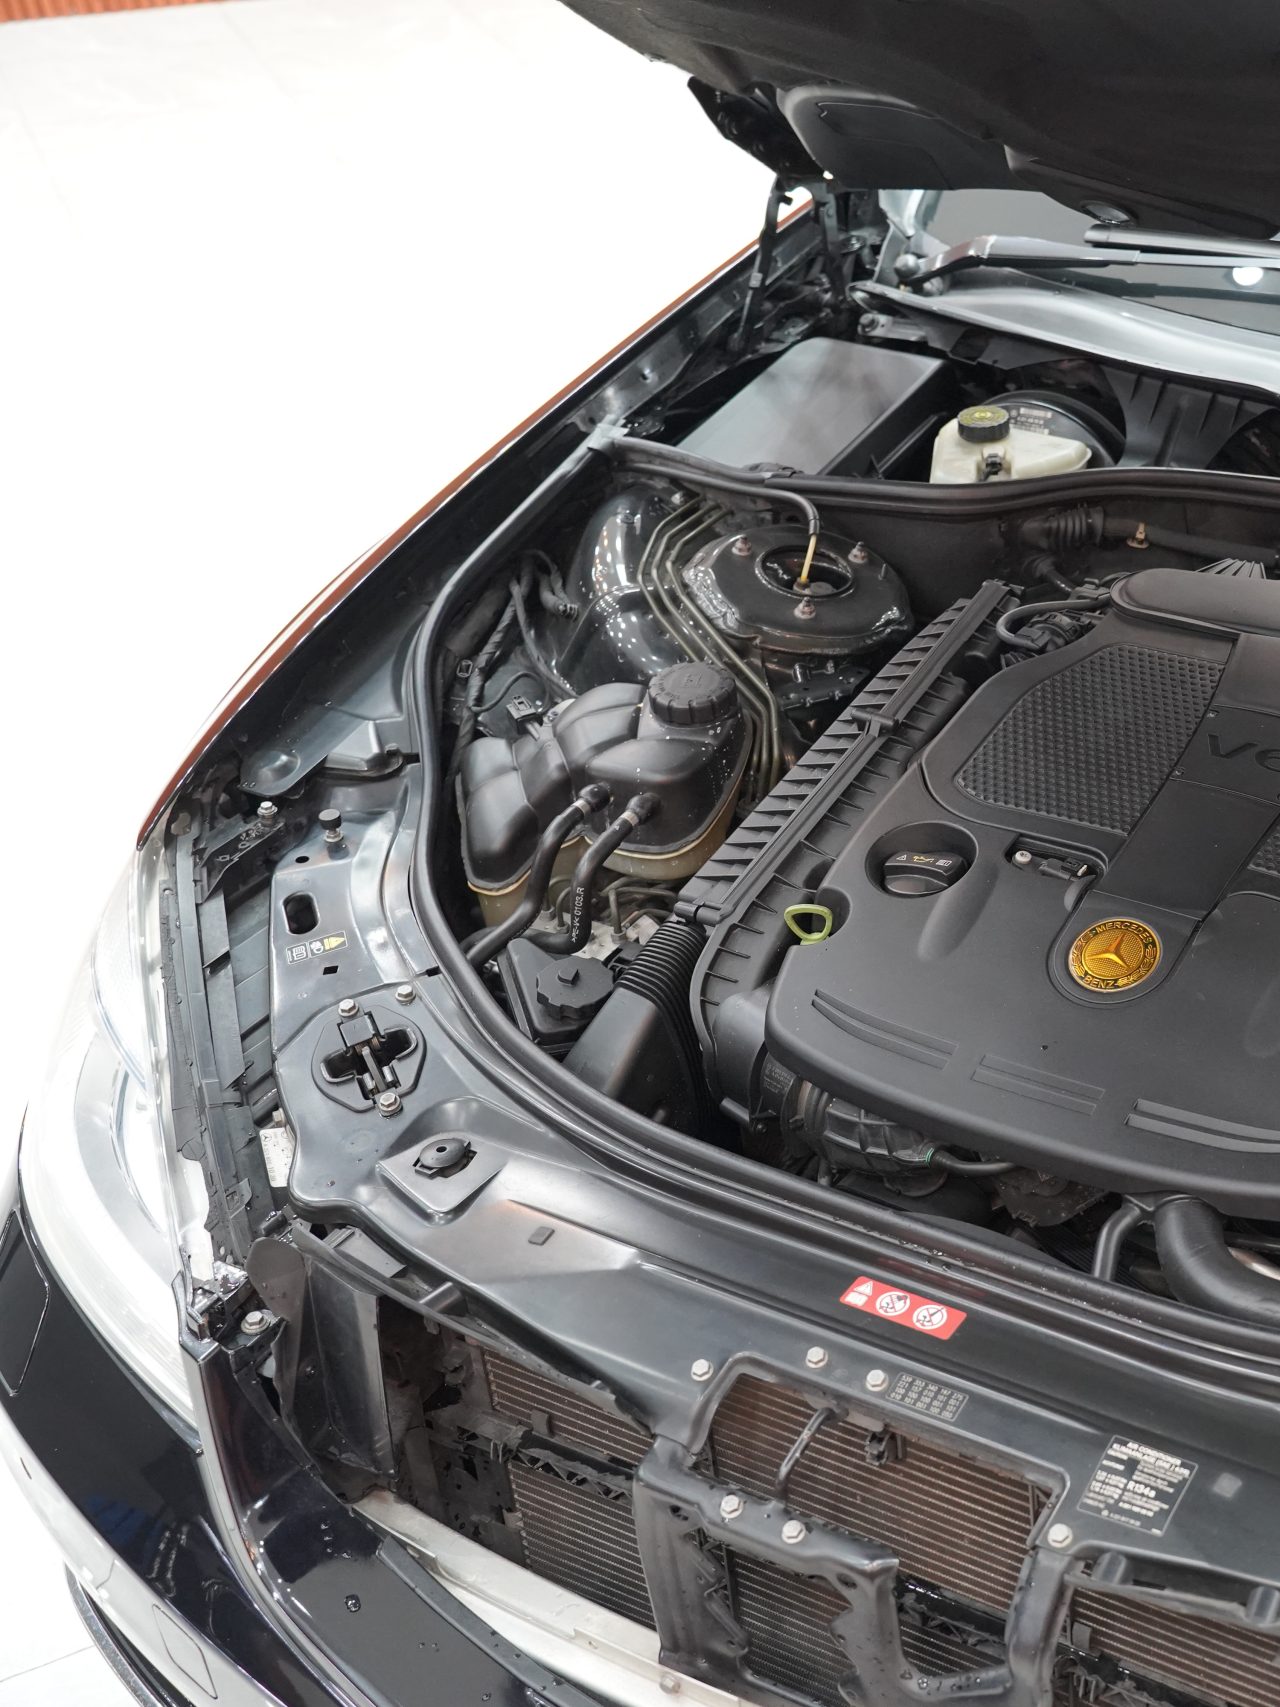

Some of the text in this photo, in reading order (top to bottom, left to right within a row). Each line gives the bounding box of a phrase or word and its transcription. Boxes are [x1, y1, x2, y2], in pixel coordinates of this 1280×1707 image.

[574, 887, 585, 916] 0103.R
[1096, 921, 1153, 946] MERCEDES
[1083, 976, 1115, 989] BENZ
[1126, 1480, 1157, 1499] R134a
